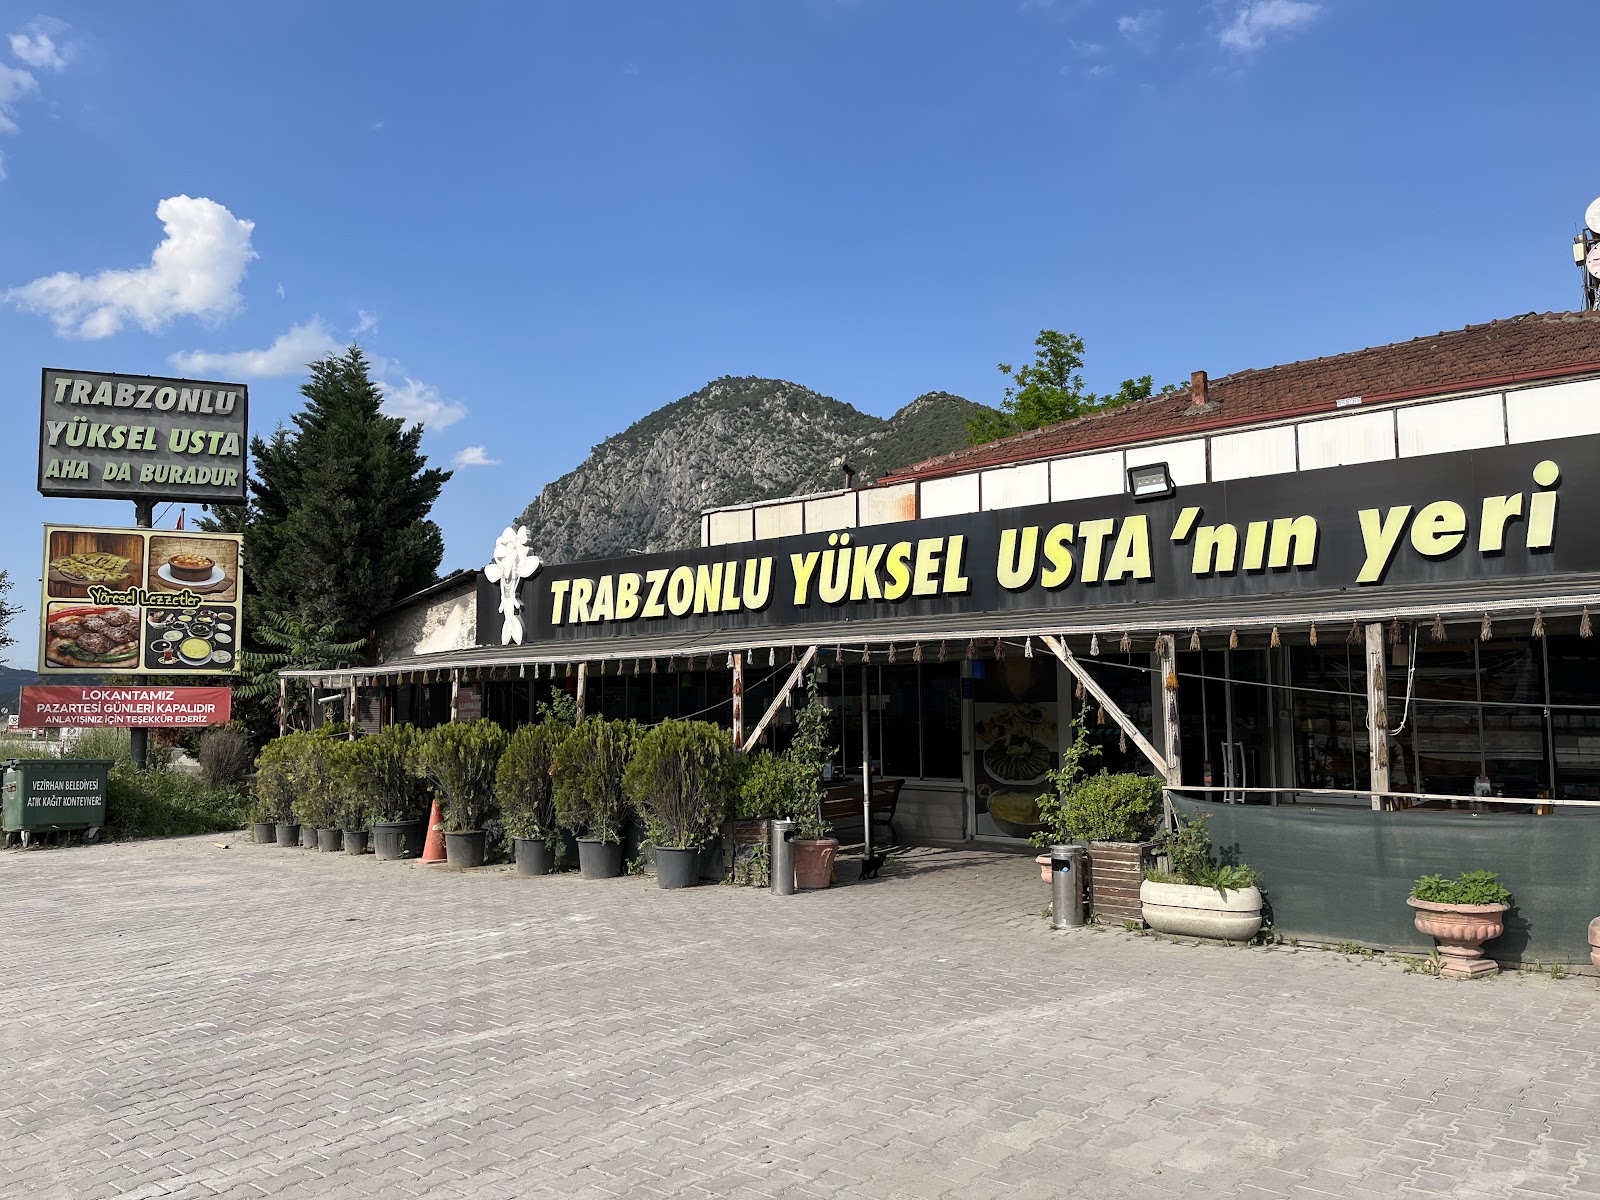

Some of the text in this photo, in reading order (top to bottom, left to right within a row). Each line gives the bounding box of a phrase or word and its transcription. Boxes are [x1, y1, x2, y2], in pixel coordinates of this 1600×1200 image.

[54, 378, 237, 415] TRABZONLU
[47, 416, 240, 456] YÜKSEL USTA
[44, 459, 239, 486] AHA DA BURADUR
[551, 557, 774, 625] TRABZONLU
[790, 533, 970, 606] YÜKSEL
[1355, 460, 1560, 583] yeri
[90, 587, 200, 606] Yöresel Lezzetler
[82, 690, 175, 700] LOKANTAMIZ
[37, 701, 216, 713] PAZARTESİ GÜNLERİ KAPALIDIR
[45, 714, 207, 725] ANLAYIŞINIZ İÇİN TEŞEKKÜR EDERİZ
[32, 778, 99, 791] VEZİRHAN BELEDİYESİ
[27, 794, 102, 807] ATIK KAĞIT KONTEYNERİ
